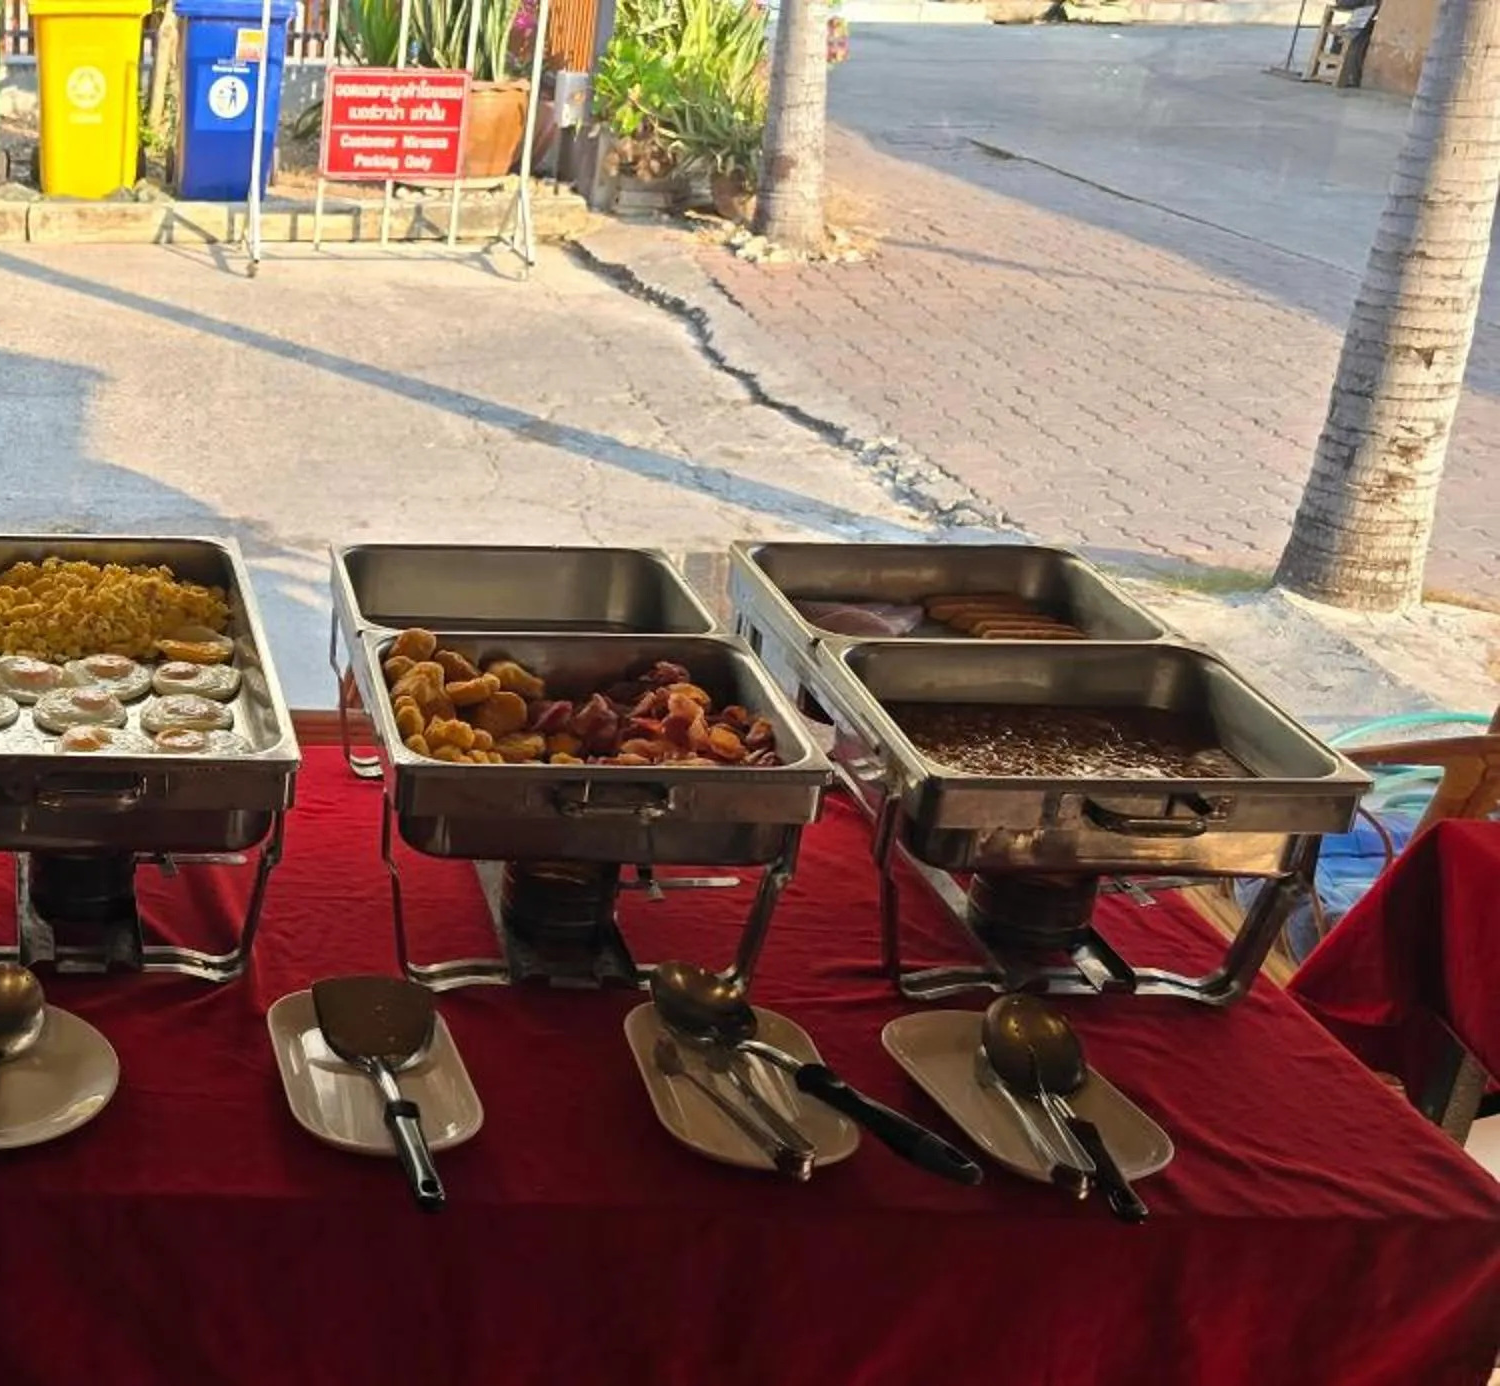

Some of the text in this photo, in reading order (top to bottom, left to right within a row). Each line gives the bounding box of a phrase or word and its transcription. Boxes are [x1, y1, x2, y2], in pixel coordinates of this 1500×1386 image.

[340, 134, 397, 148] Customer
[353, 154, 432, 171] Parking Only
